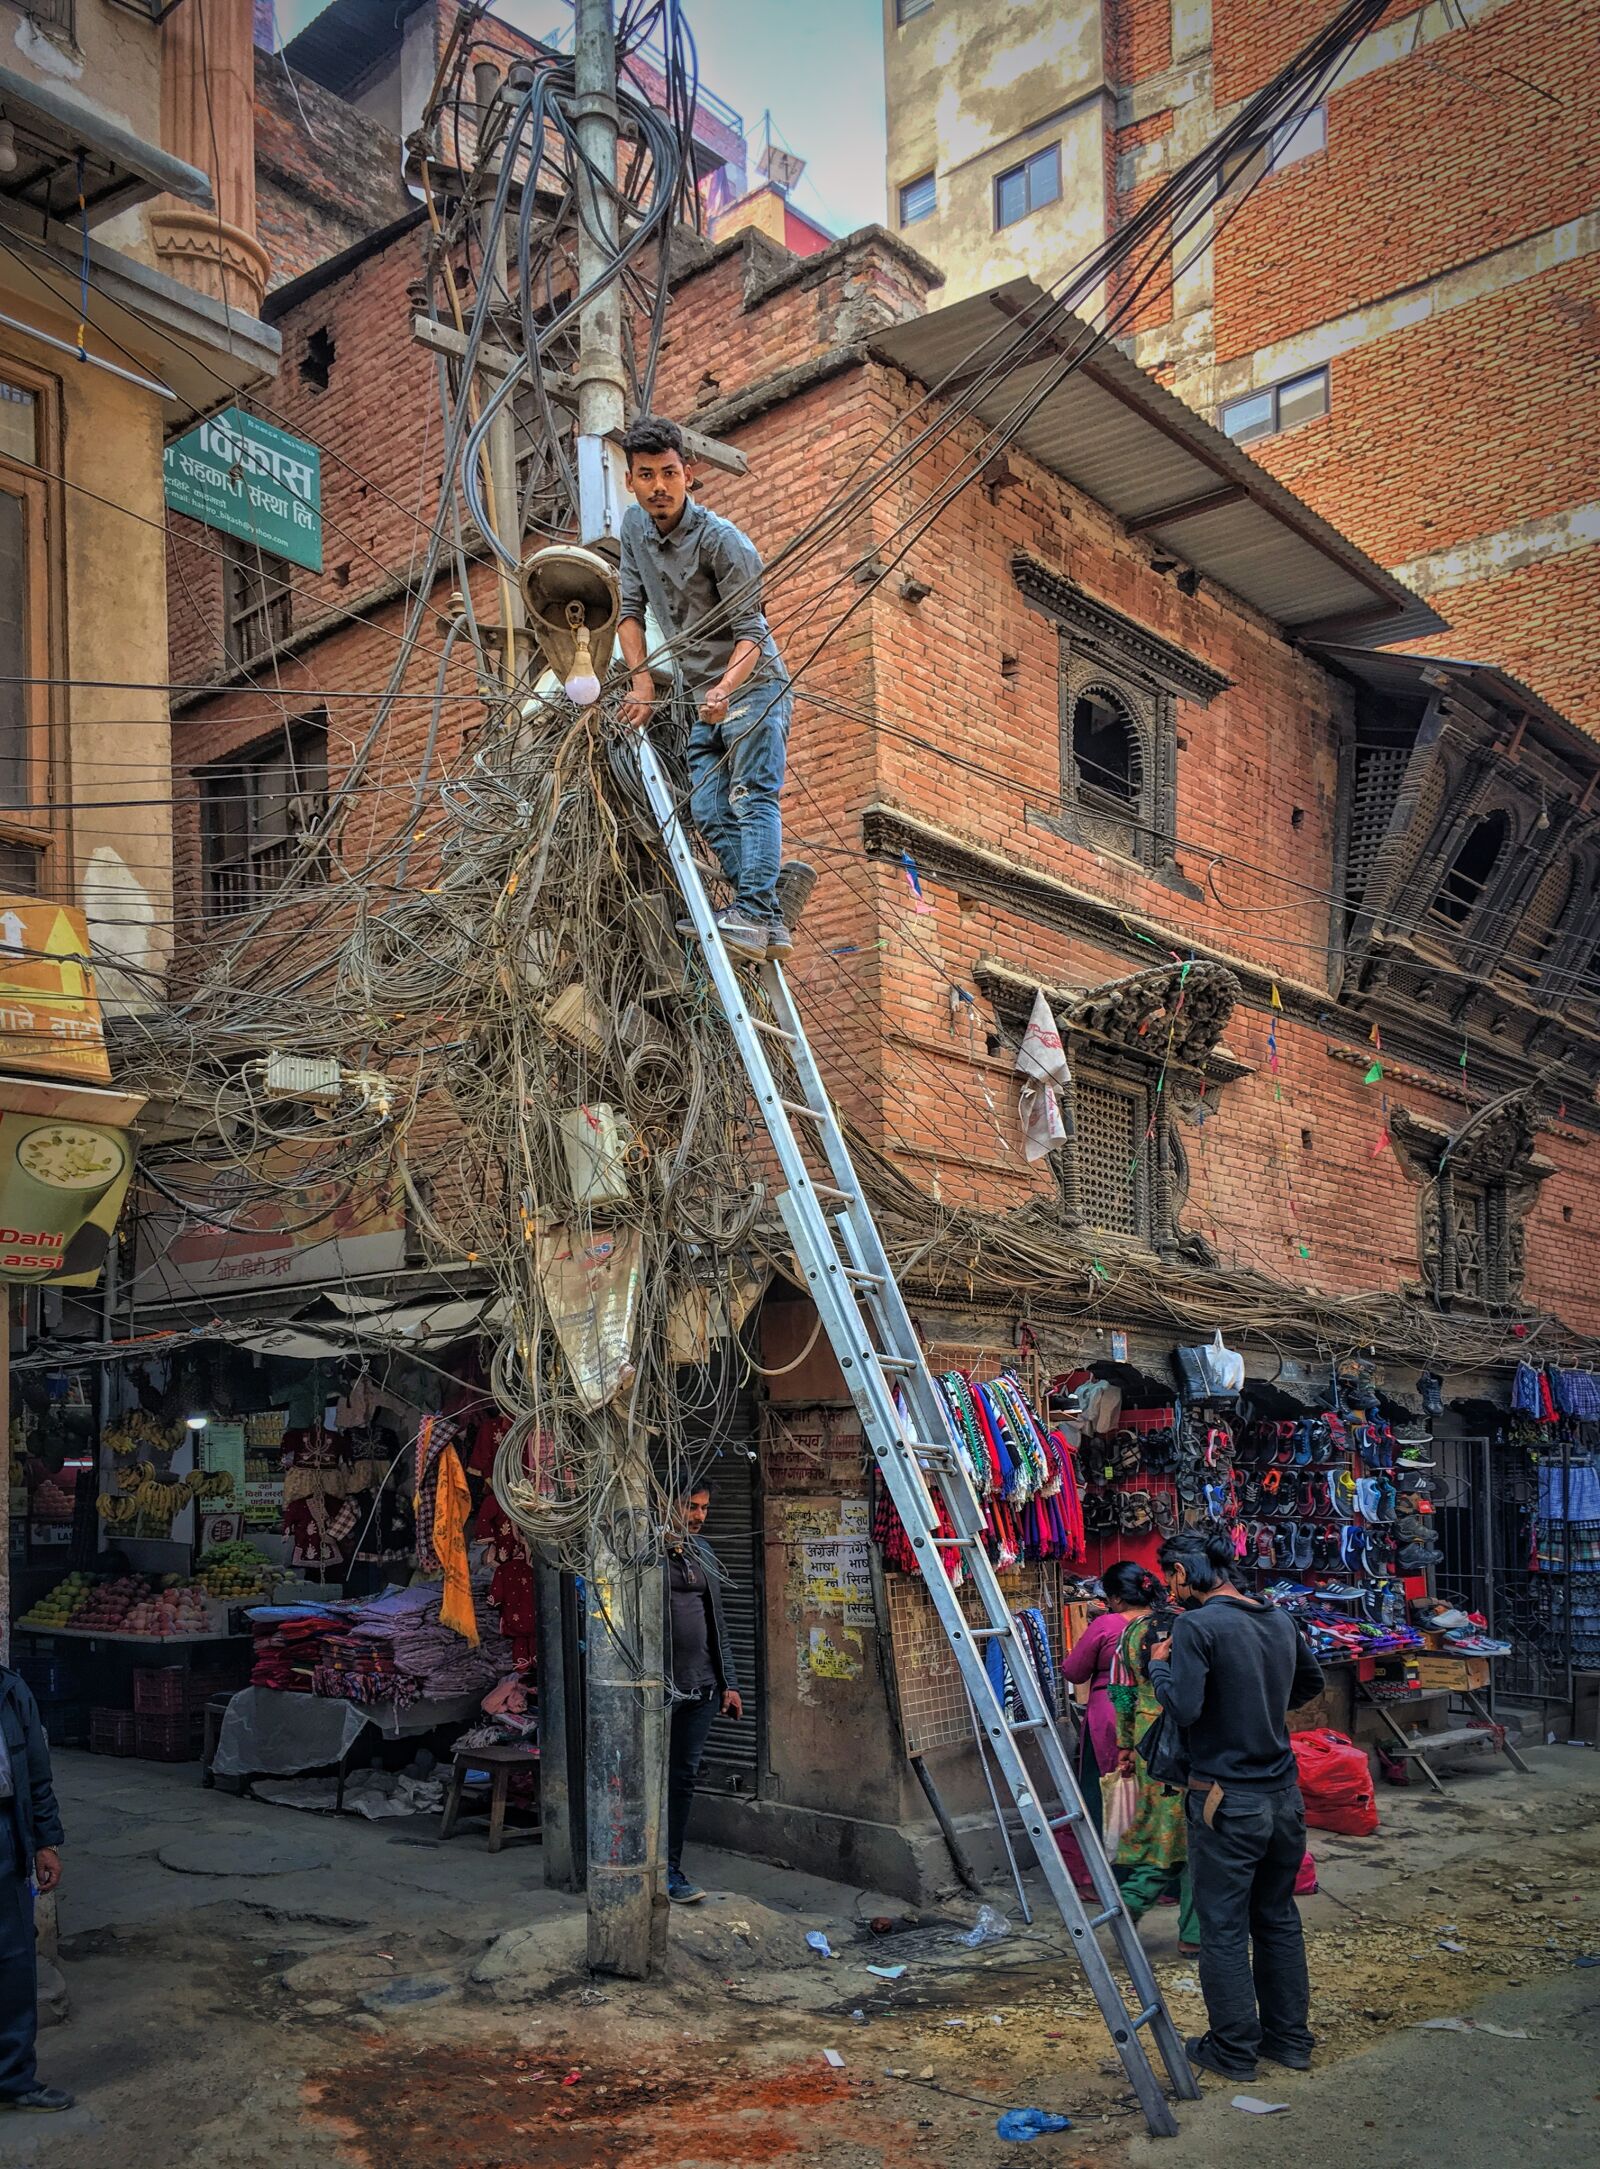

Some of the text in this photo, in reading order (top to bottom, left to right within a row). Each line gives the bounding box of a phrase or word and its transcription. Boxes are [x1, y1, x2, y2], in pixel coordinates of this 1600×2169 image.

[199, 414, 314, 501] विकास
[248, 484, 289, 520] संस्था
[0, 1229, 64, 1248] Dahi
[0, 1254, 64, 1270] assi
[811, 1561, 836, 1572] भाषा
